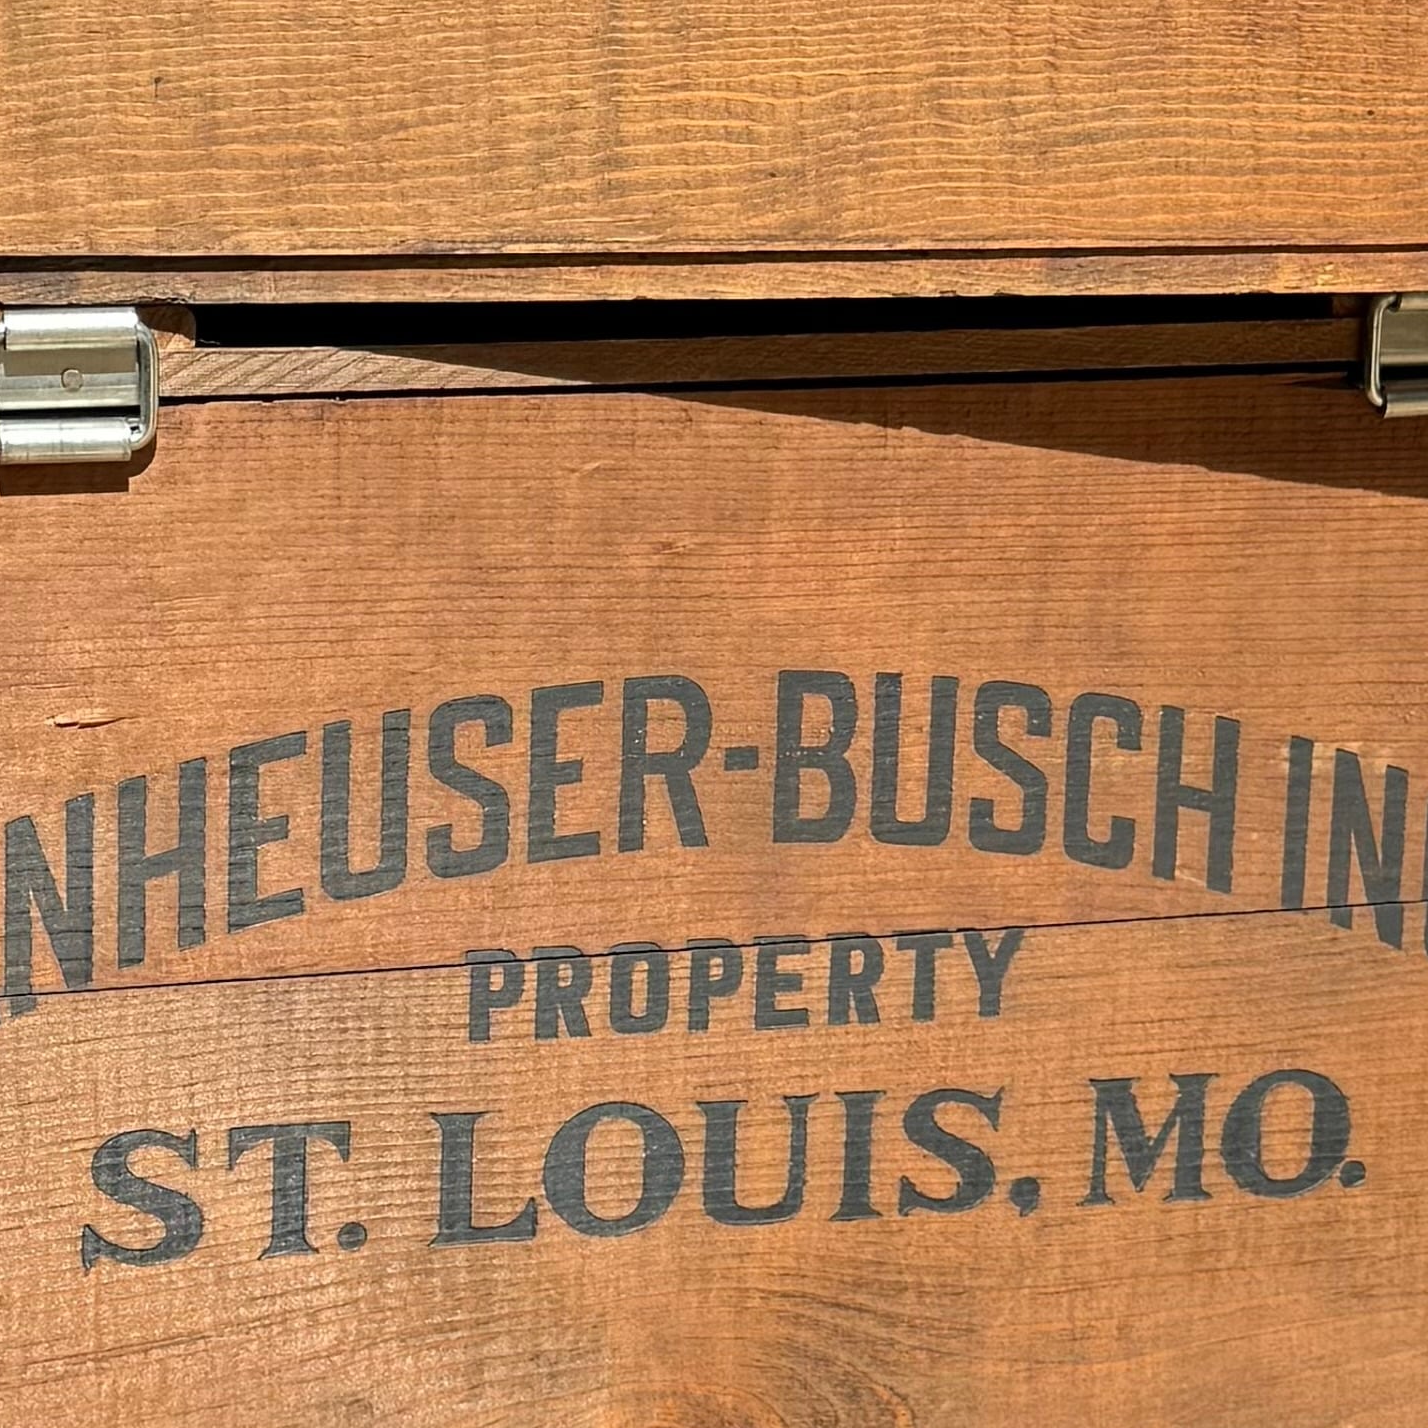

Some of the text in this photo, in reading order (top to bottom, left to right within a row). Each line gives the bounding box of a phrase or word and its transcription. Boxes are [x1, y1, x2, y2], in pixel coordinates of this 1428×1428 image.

[465, 929, 1027, 1043] PROPERTY
[81, 1068, 1366, 1273] ST. LOUIS, MO.
